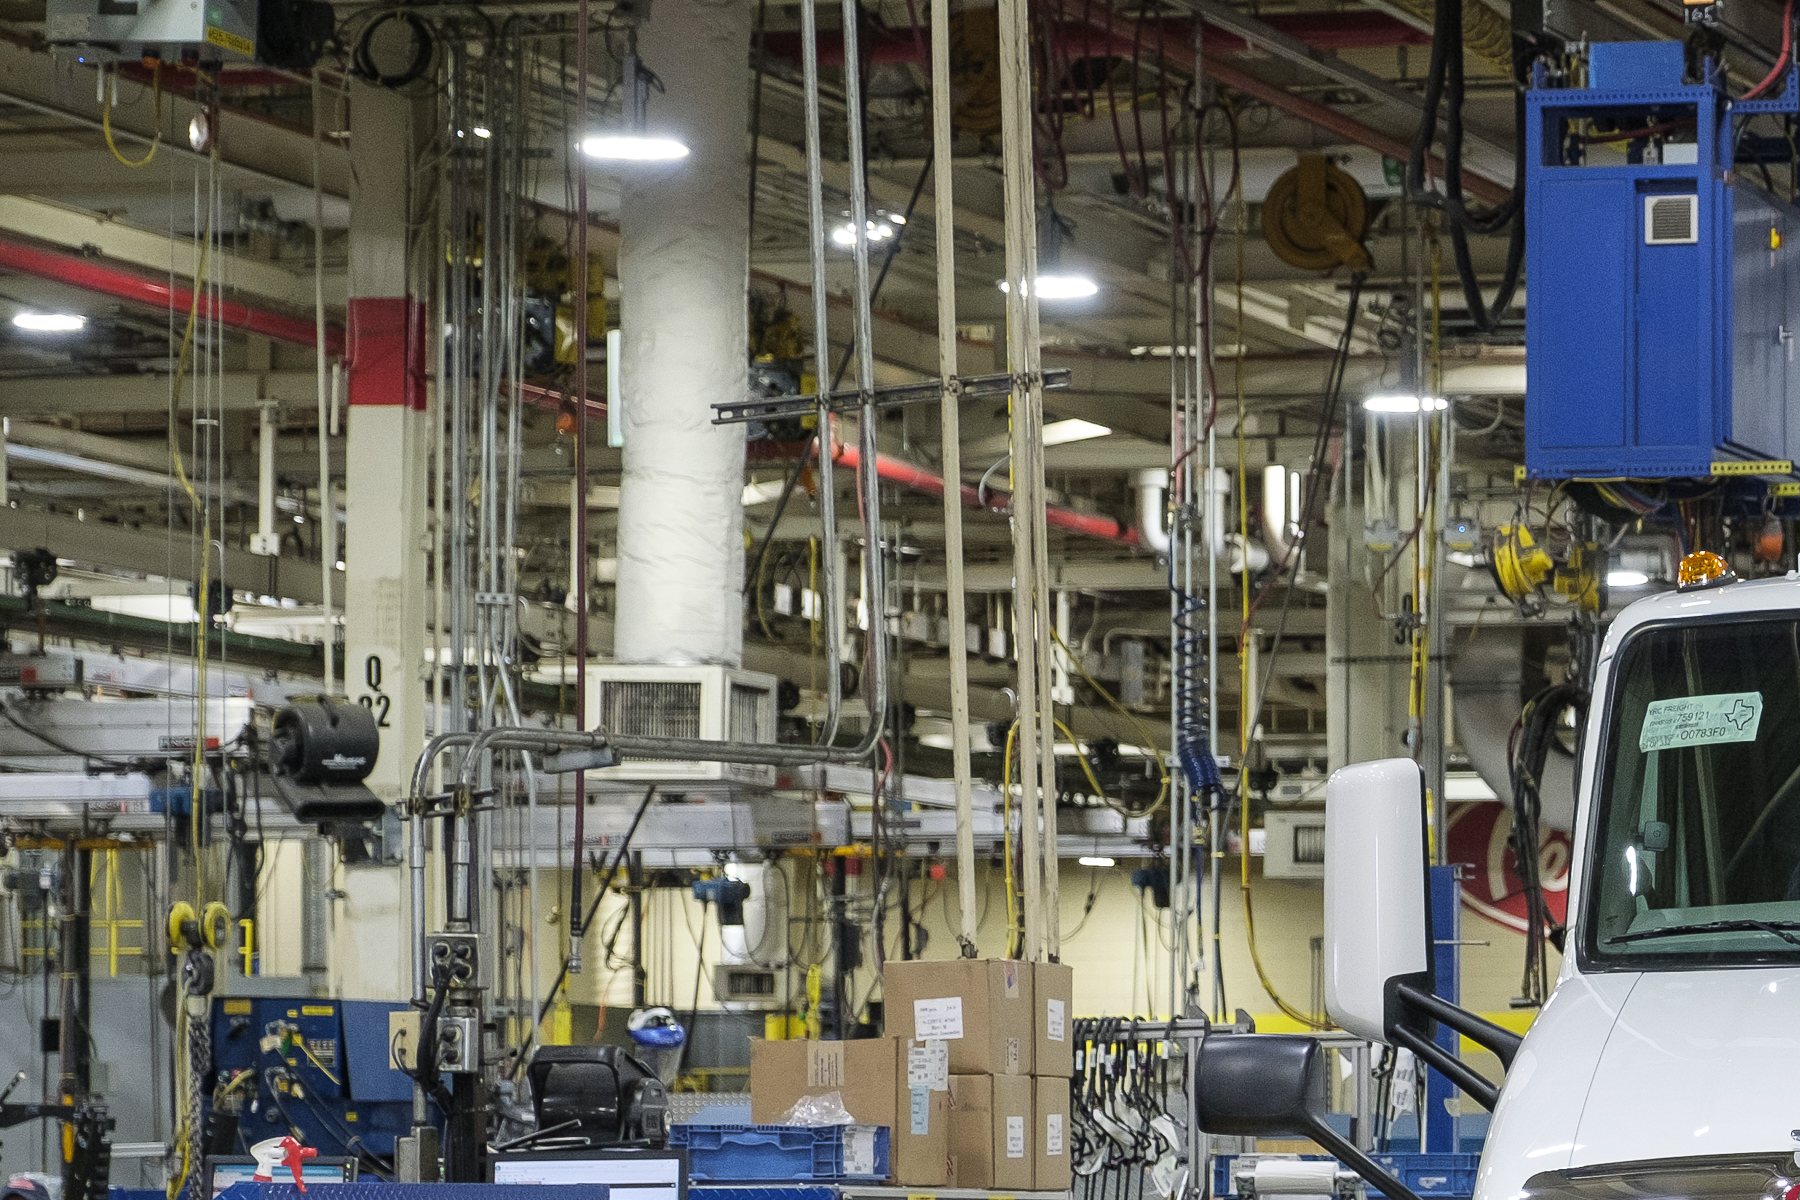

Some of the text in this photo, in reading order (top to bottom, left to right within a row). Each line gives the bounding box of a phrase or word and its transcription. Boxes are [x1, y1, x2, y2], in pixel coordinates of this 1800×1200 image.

[365, 655, 381, 691] Q
[1664, 703, 1694, 714] FREIGHT
[1677, 711, 1711, 723] 759121
